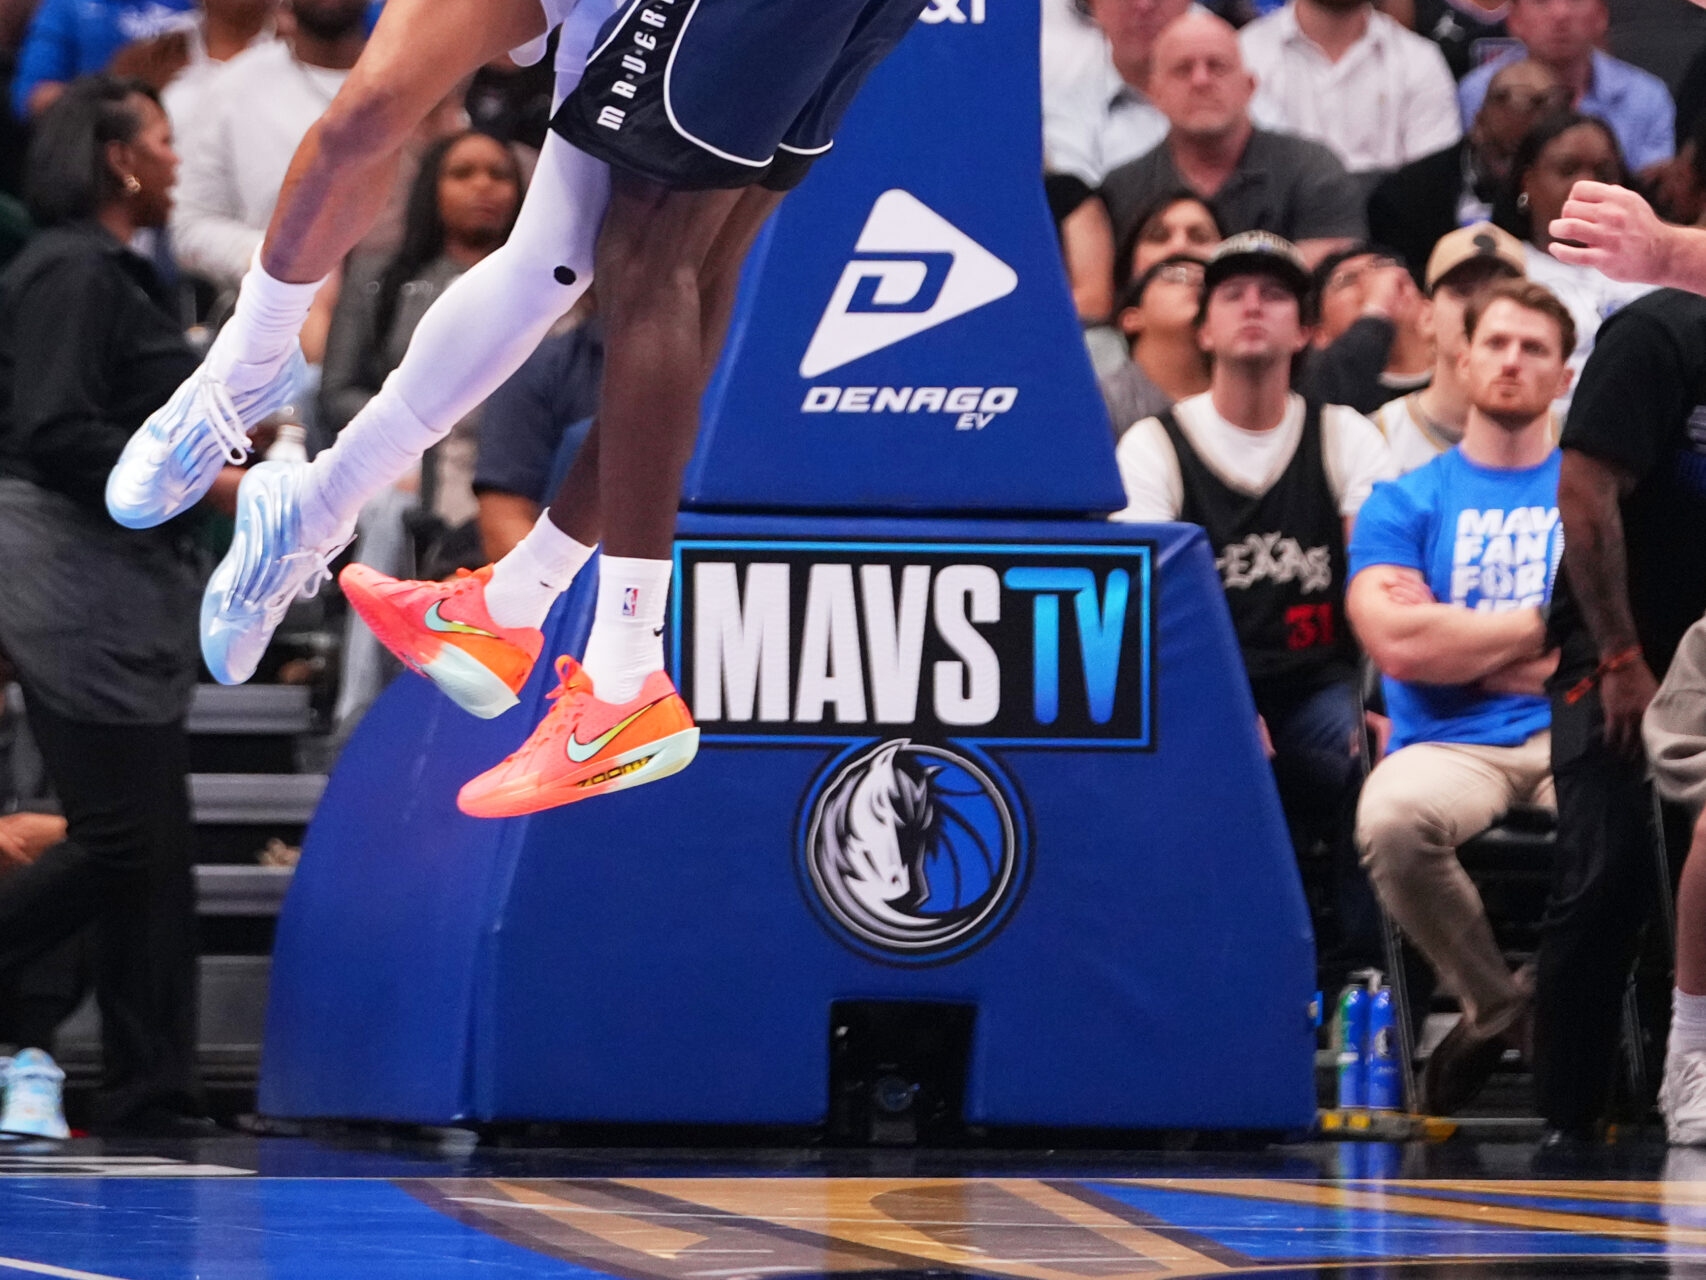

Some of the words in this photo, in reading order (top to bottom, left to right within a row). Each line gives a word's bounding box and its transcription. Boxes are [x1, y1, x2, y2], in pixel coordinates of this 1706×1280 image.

[801, 386, 1019, 413] DENAGO
[955, 412, 996, 431] EV
[1215, 531, 1332, 594] EXAS
[1454, 534, 1549, 566] FAN
[1450, 561, 1547, 600] FOR
[693, 561, 1001, 726] MAVS
[1003, 566, 1130, 725] TV
